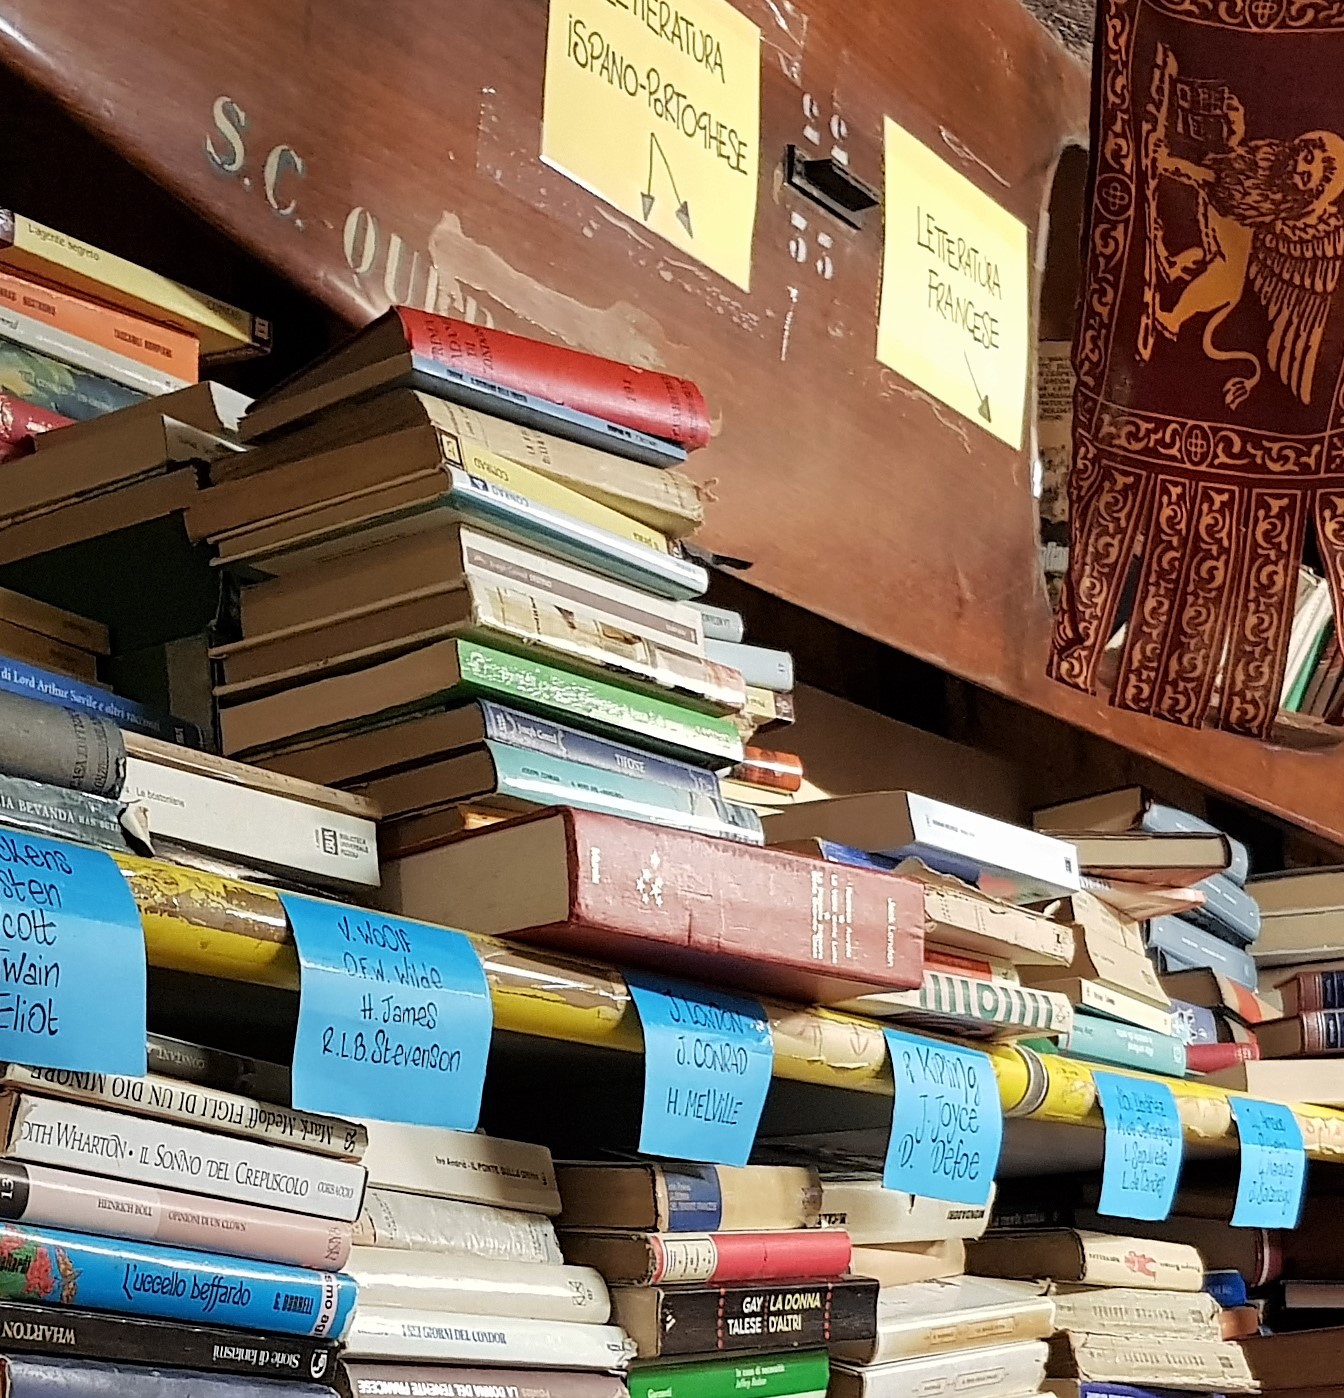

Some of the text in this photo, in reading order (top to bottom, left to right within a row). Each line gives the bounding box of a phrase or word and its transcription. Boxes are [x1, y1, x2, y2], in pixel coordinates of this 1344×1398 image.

[394, 962, 442, 990] Wilde
[381, 1001, 439, 1030] James
[694, 1042, 749, 1076] CONRAD
[686, 1090, 744, 1126] MELVILLE
[932, 1098, 980, 1141] Joyce
[139, 1146, 150, 1164] IL
[154, 1145, 202, 1174] SONNO
[208, 1157, 230, 1180] DEL
[235, 1163, 309, 1196] CREPUSCOLO
[932, 1140, 980, 1182] Defoe
[124, 1264, 251, 1313] L'uccello beffardo
[769, 1292, 821, 1311] LA DONNA
[743, 1296, 763, 1313] GAY
[727, 1317, 762, 1336] TALESE
[768, 1315, 802, 1333] D'ALTRI
